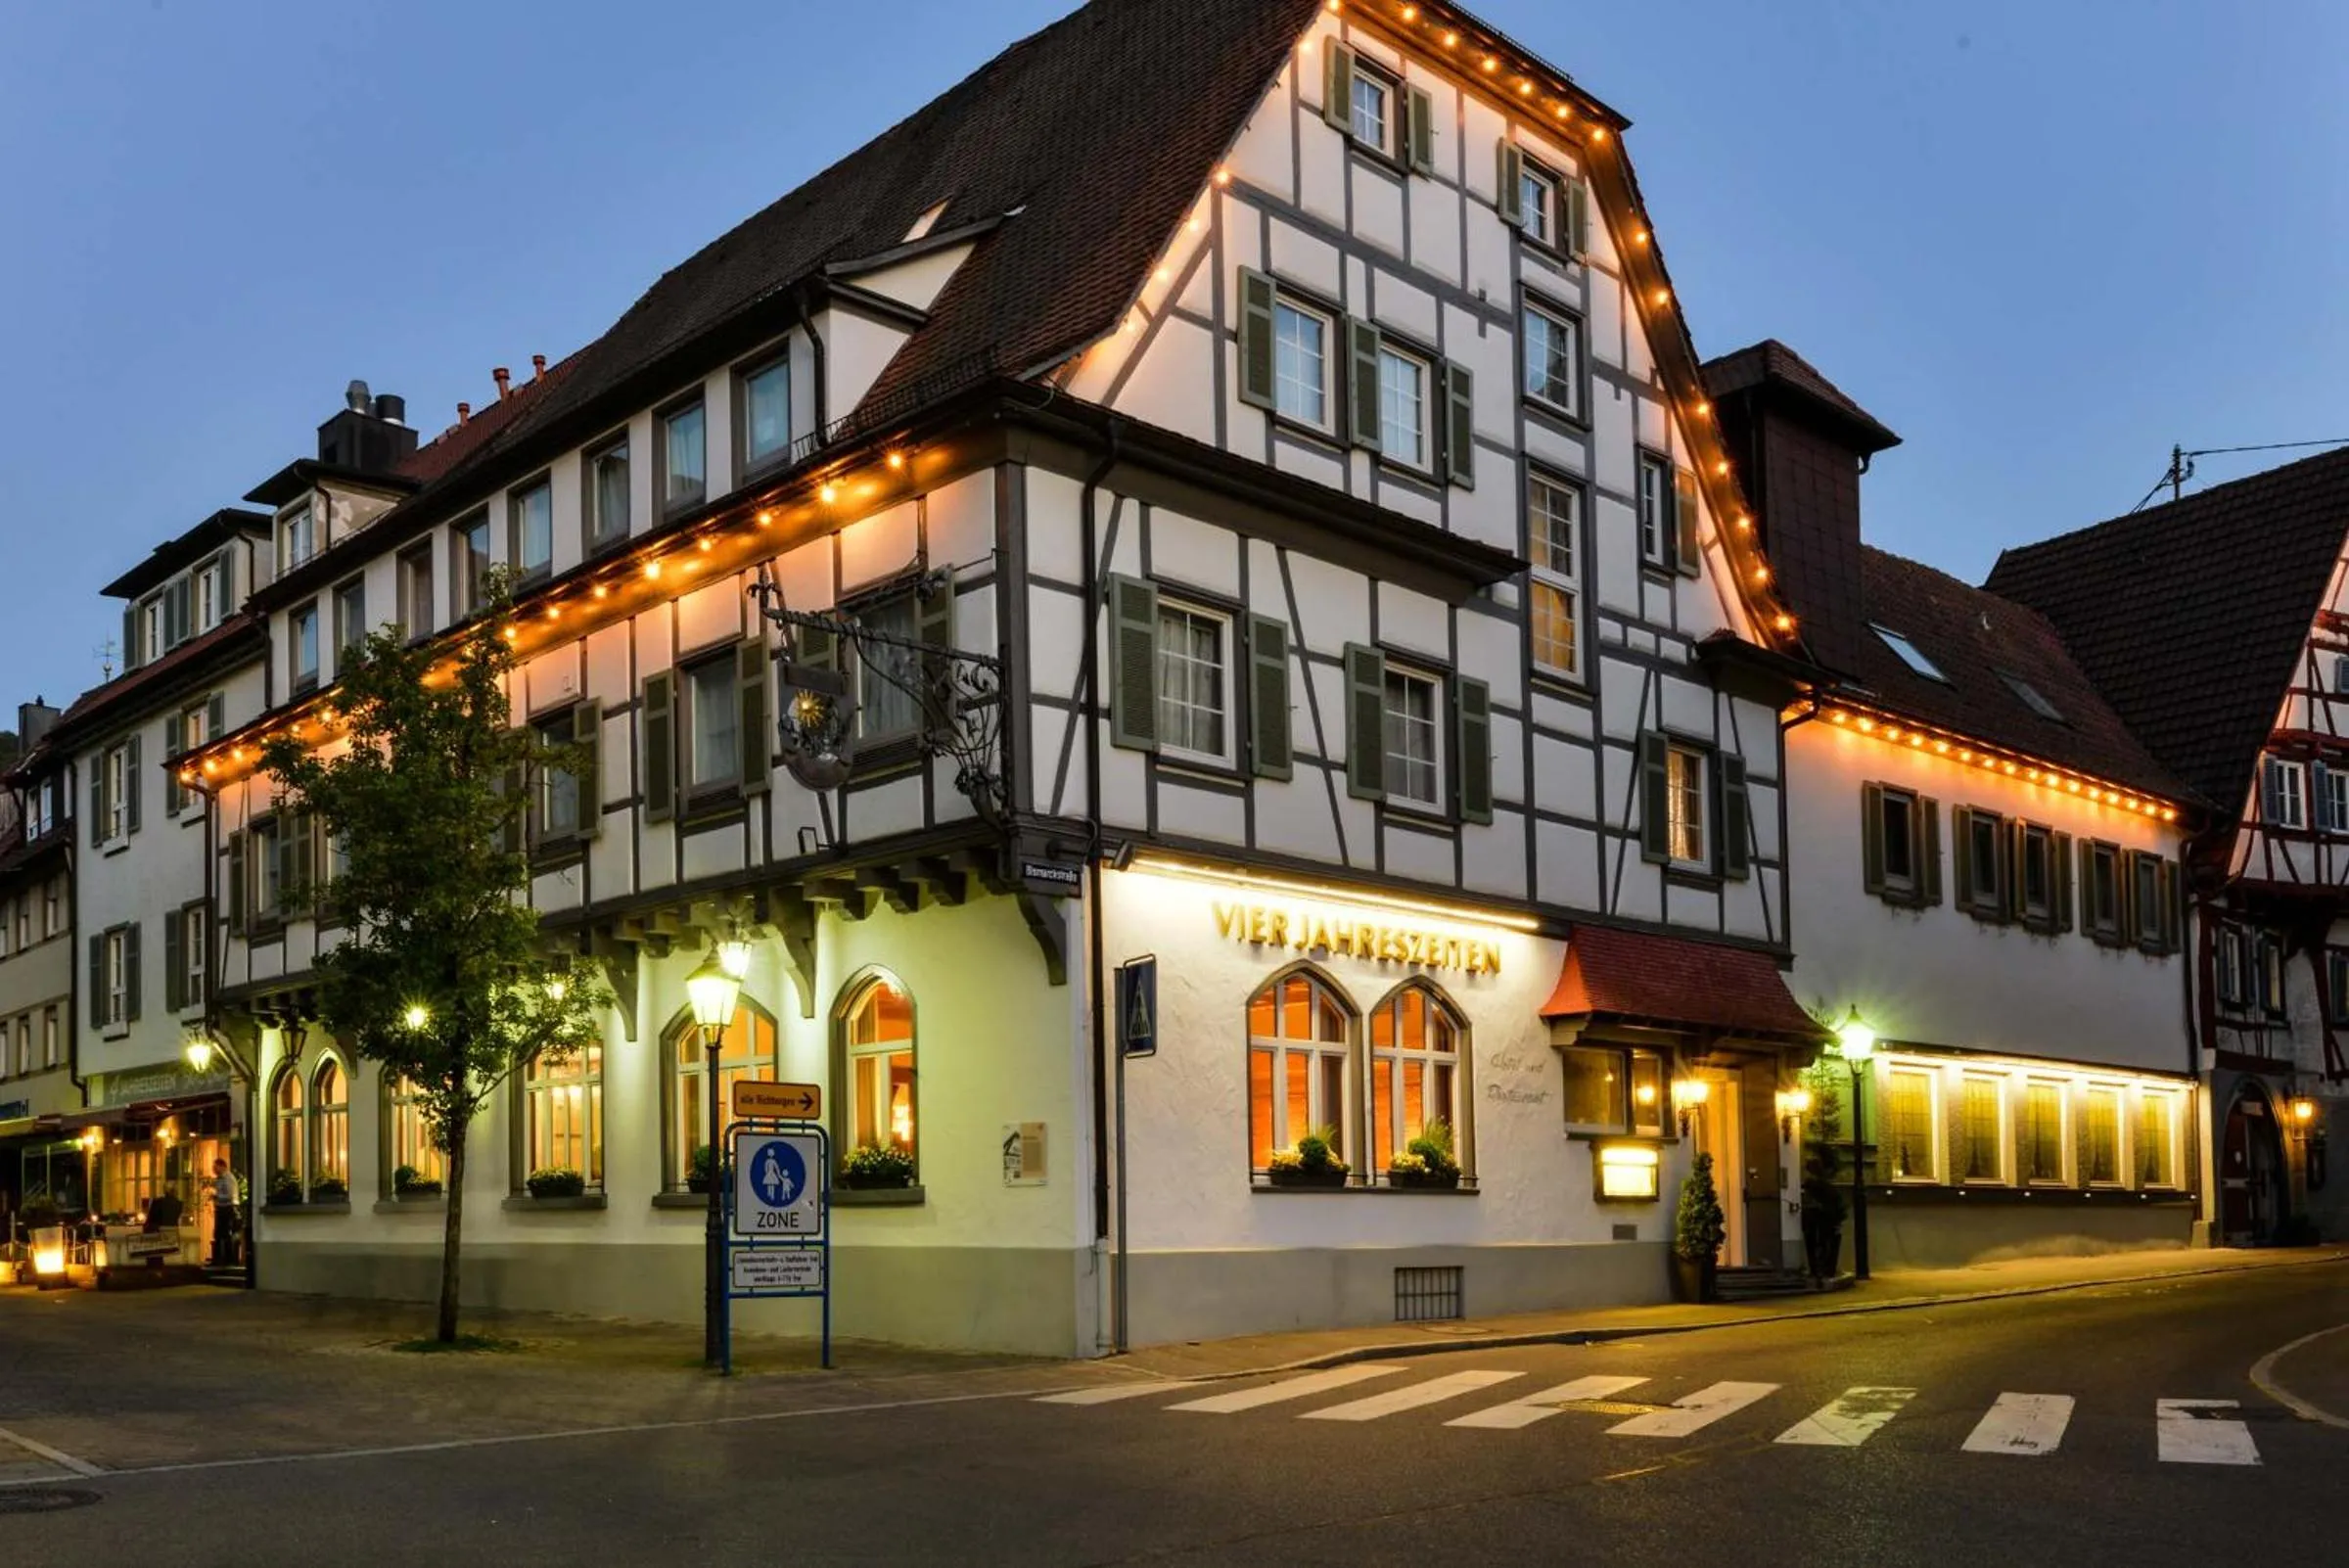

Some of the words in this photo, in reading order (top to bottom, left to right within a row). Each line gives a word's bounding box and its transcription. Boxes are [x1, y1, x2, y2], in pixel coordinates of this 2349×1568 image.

[1212, 901, 1289, 947] VIER
[1294, 916, 1502, 975] JAHRESZEITEN
[758, 1212, 799, 1228] ZONE
